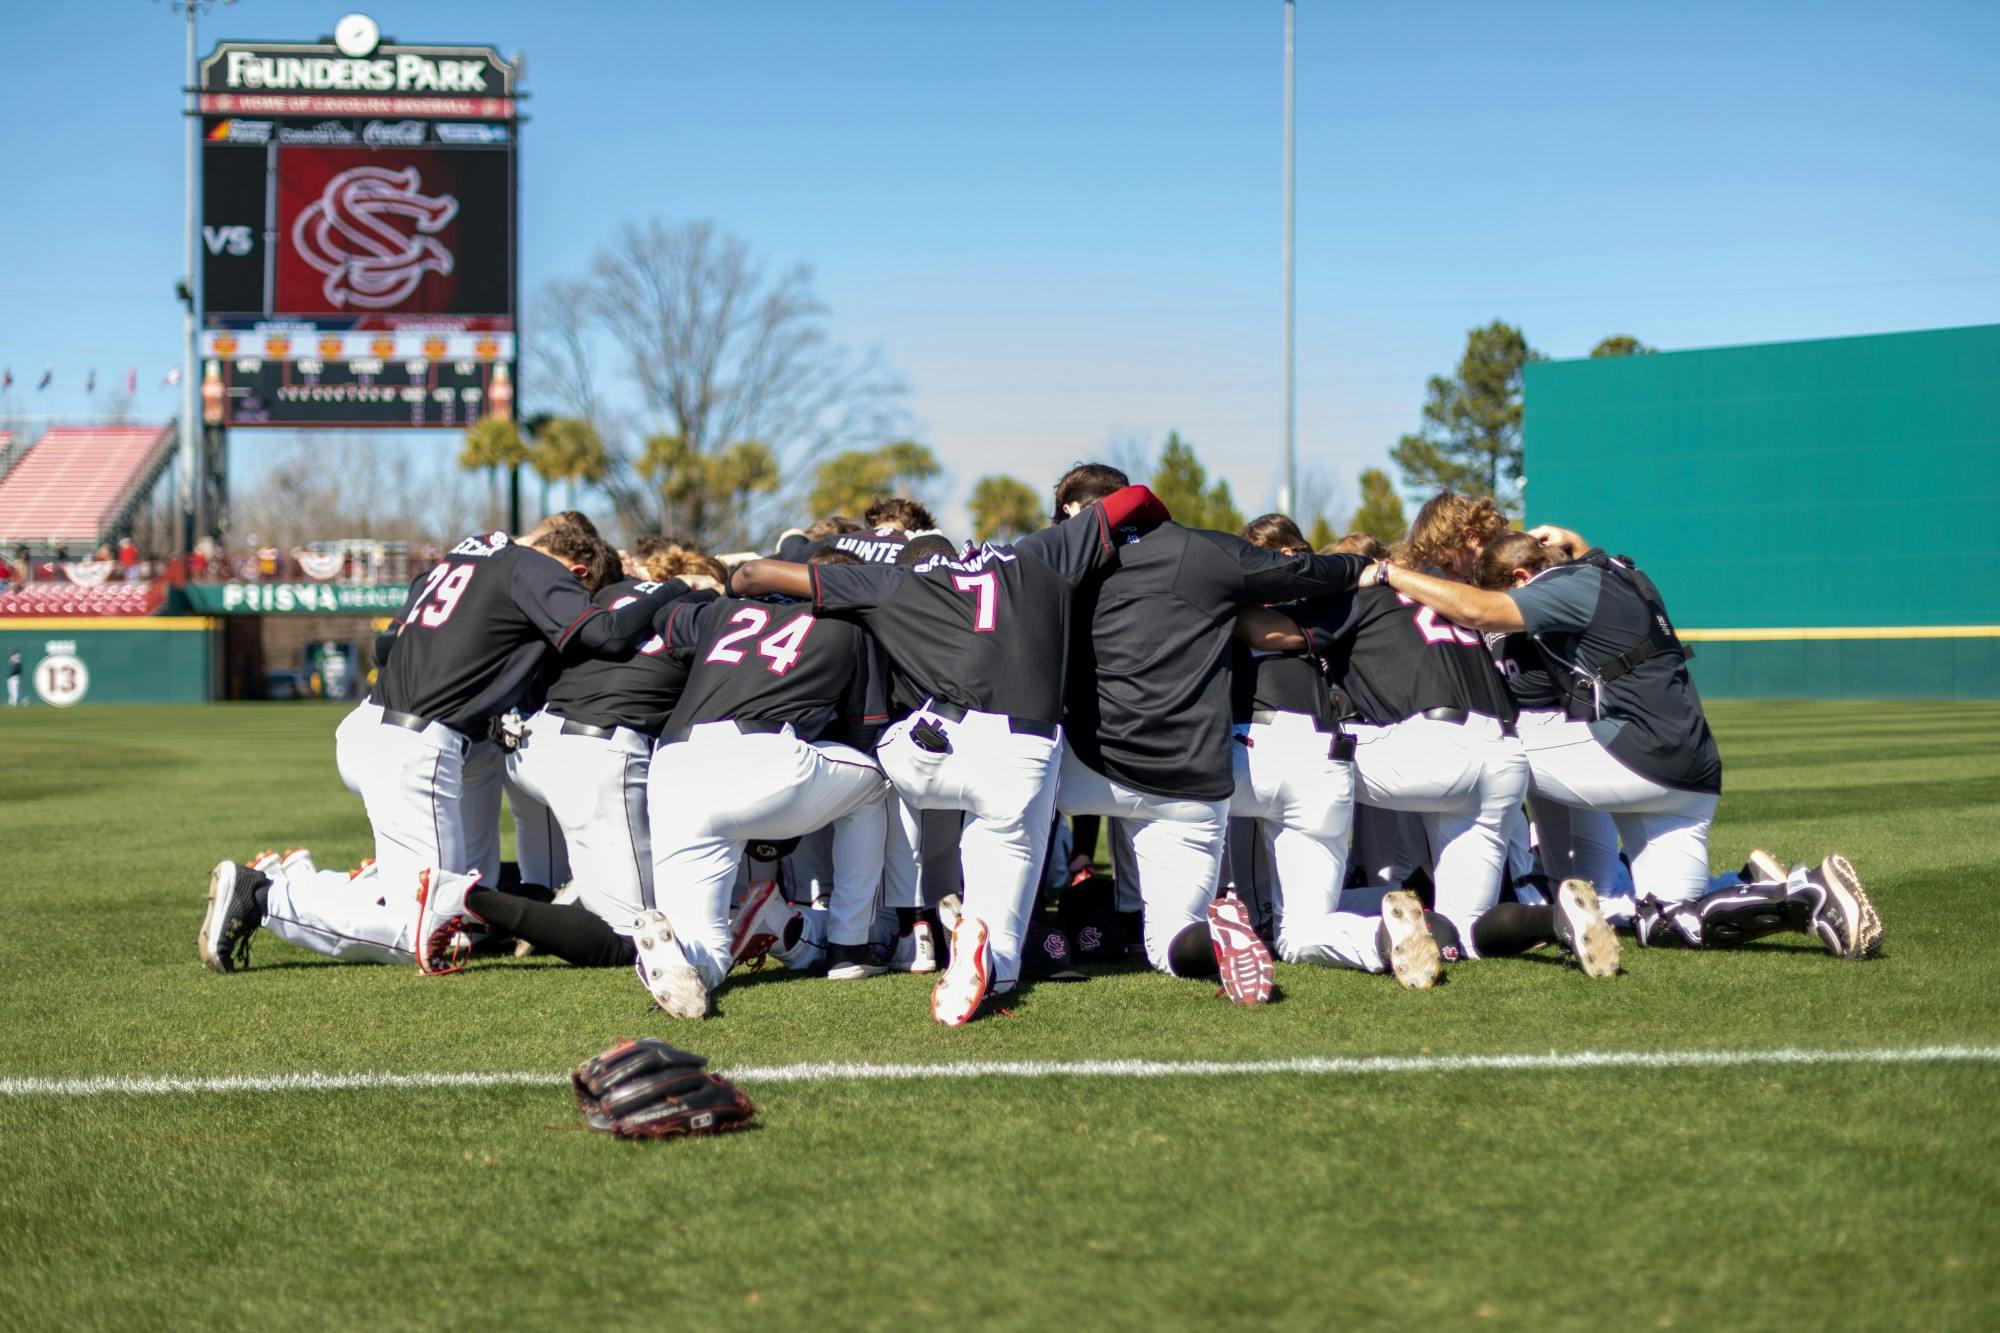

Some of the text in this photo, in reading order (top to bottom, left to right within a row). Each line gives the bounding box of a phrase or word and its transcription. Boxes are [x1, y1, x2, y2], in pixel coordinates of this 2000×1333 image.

[227, 52, 487, 91] FOUNDERS PARK
[240, 96, 286, 111] HOME
[288, 96, 313, 111] OF
[203, 225, 254, 256] VS
[223, 583, 338, 611] PRISMA
[406, 561, 477, 628] 29
[951, 571, 998, 632] 7
[704, 606, 816, 677] 24
[47, 664, 77, 693] 13
